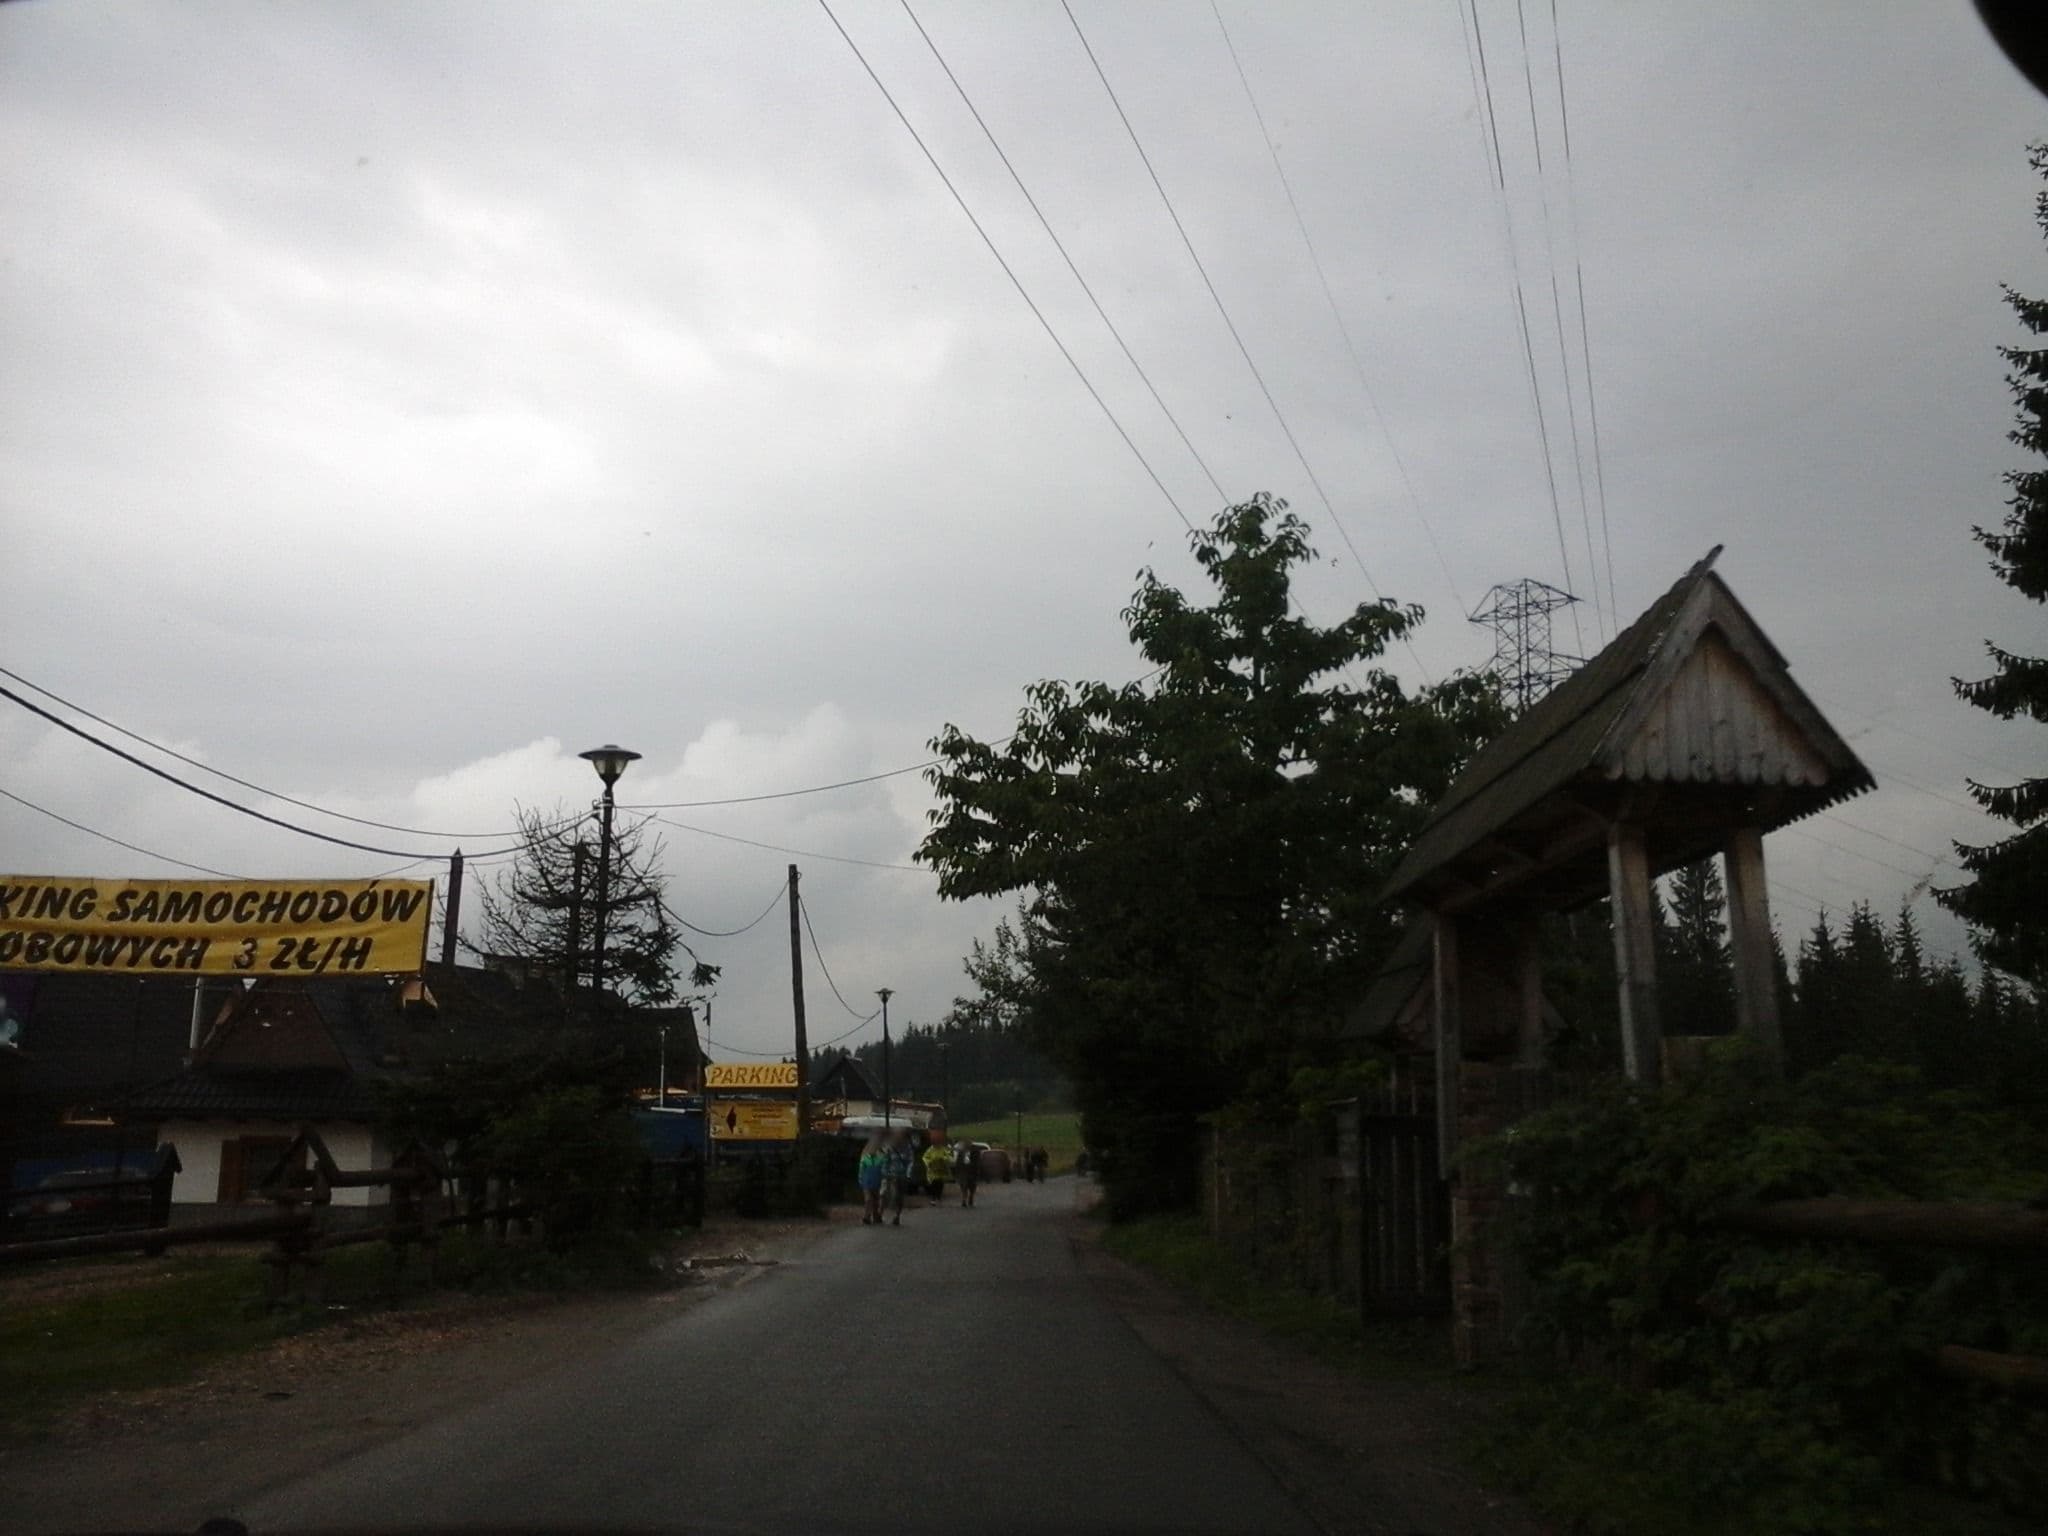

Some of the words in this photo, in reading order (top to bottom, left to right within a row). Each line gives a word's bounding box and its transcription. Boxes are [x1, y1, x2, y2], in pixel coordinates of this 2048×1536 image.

[107, 881, 422, 923] SAMOCHODÓW
[0, 931, 210, 969] OBOWYCH
[233, 937, 258, 970] 3
[711, 1067, 797, 1084] PARKING
